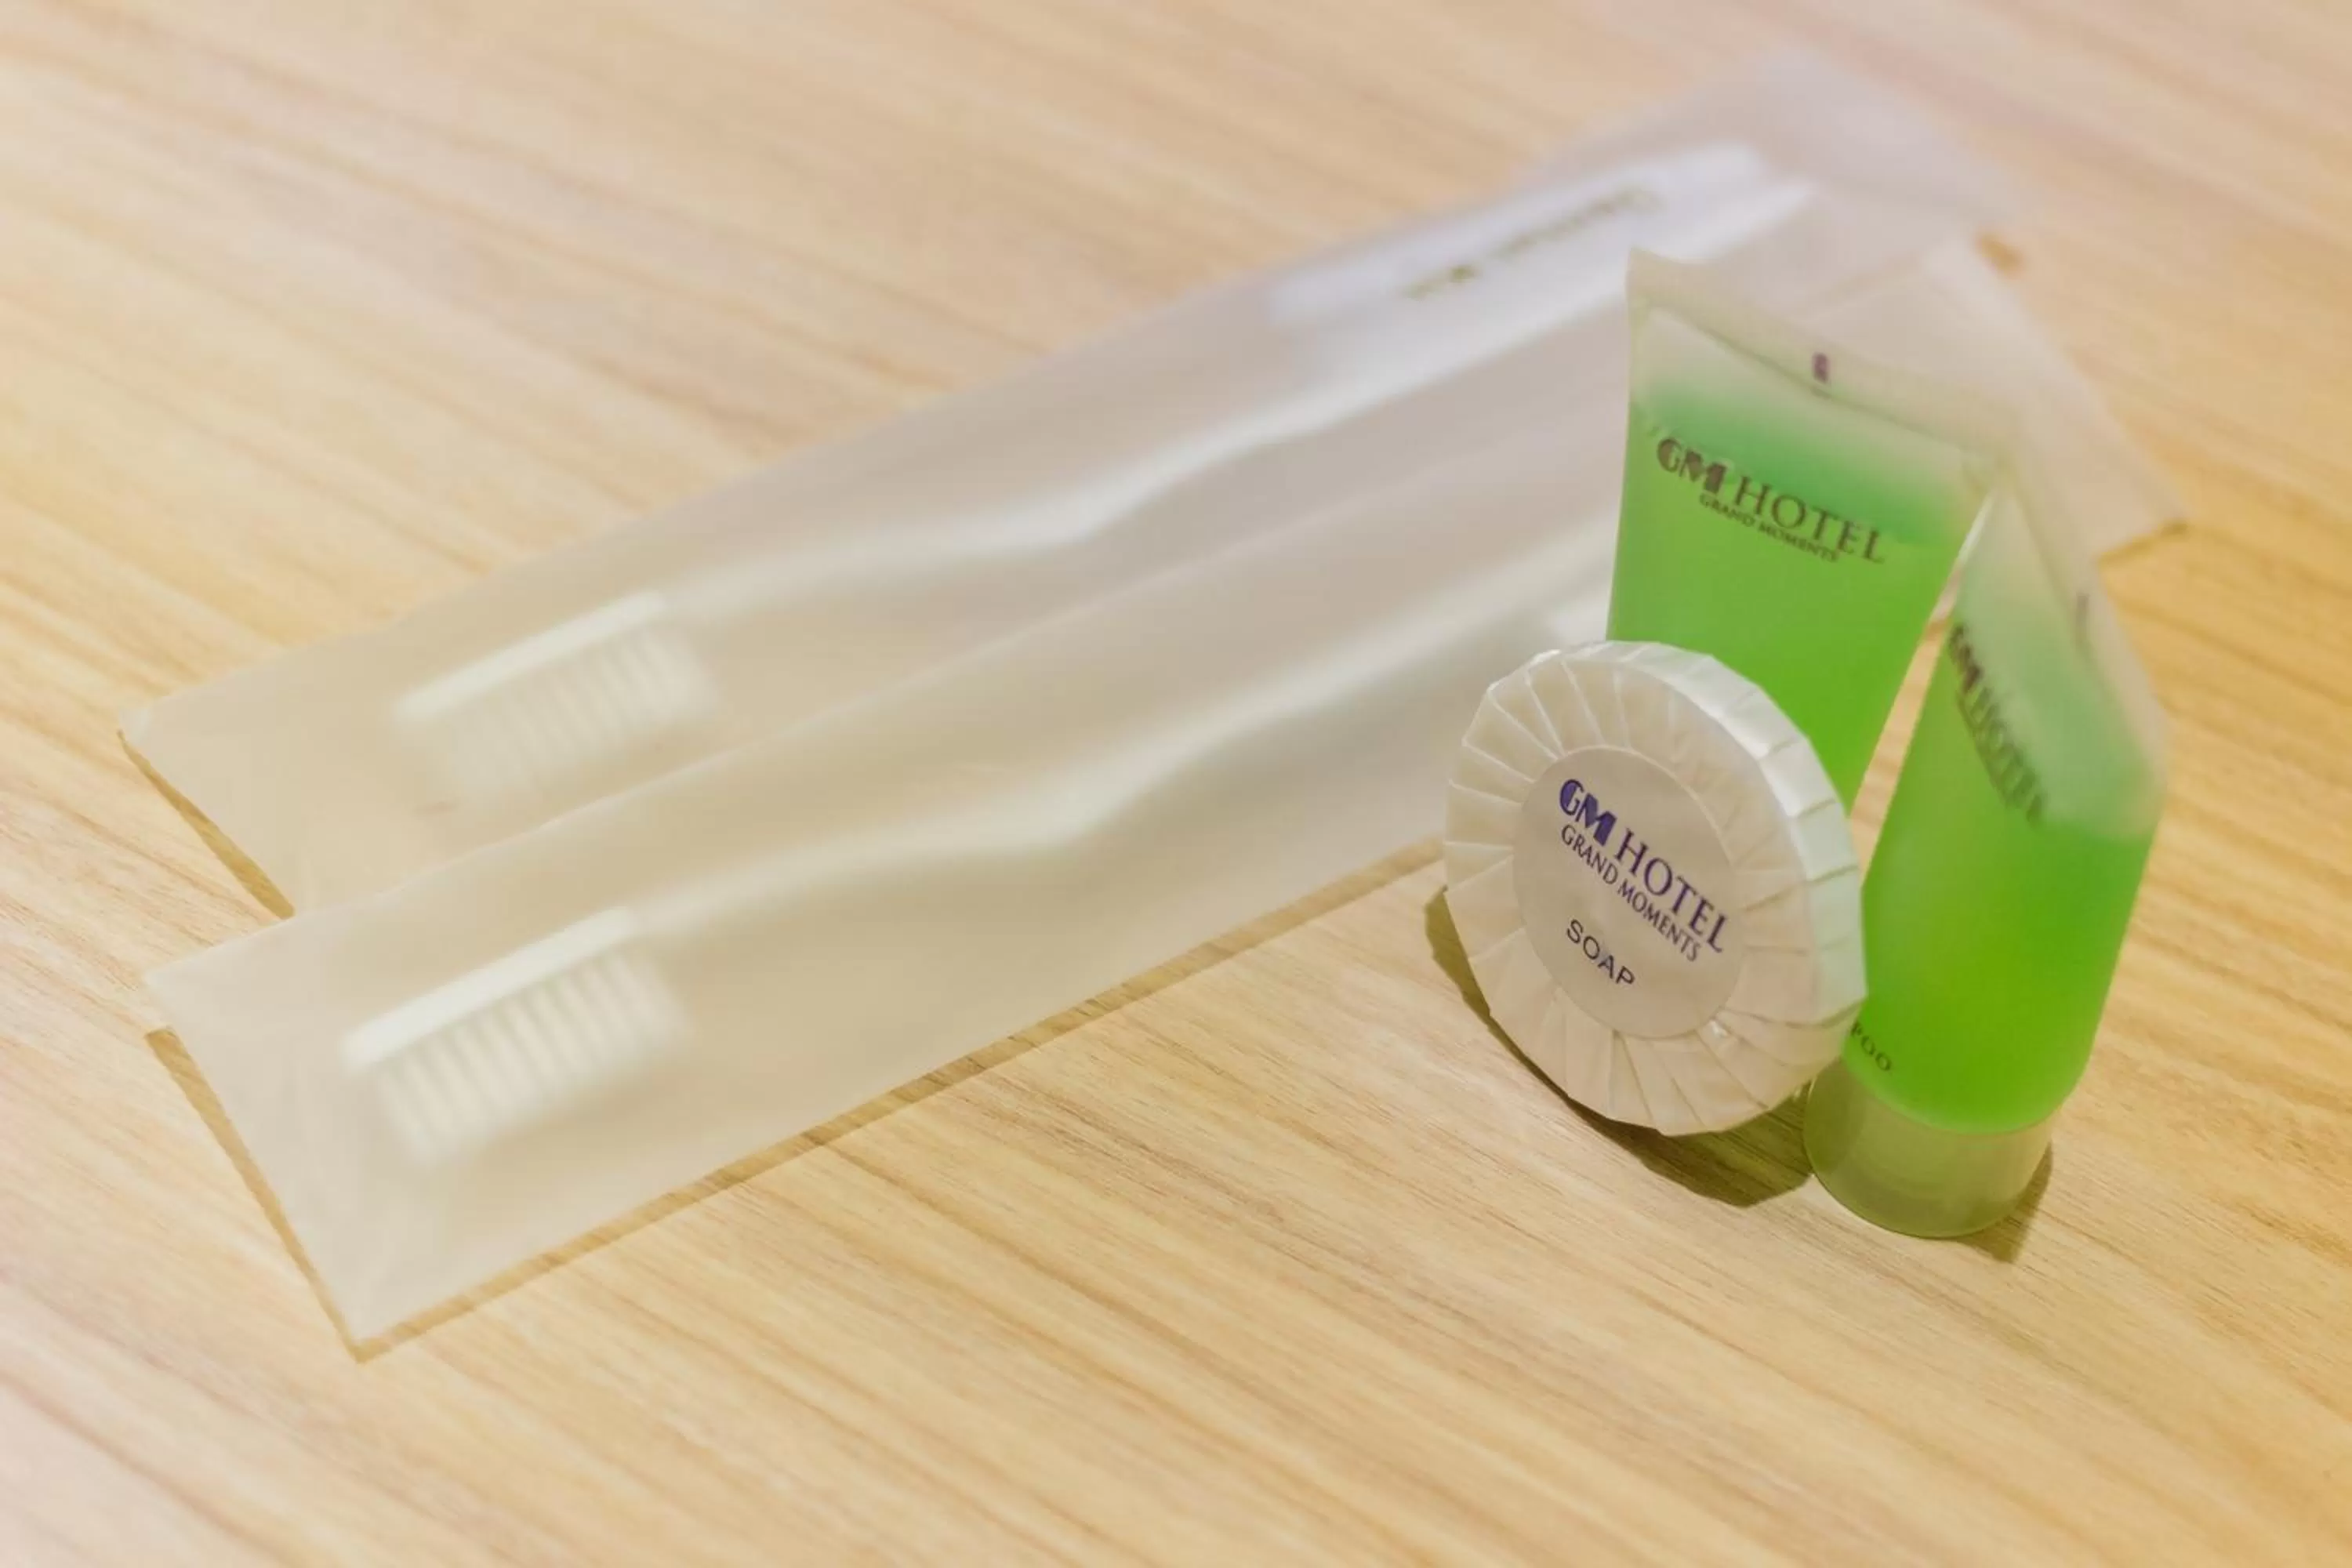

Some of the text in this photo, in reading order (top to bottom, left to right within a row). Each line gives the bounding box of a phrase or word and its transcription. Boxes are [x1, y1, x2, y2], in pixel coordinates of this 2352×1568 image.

[1657, 437, 1885, 564] GM HOTEL
[1699, 492, 1839, 564] GRAND MOMENTS
[1559, 779, 1729, 954] GM HOTEL
[1561, 824, 1702, 963] GRAND MOMENTS
[1566, 919, 1635, 985] SOAP
